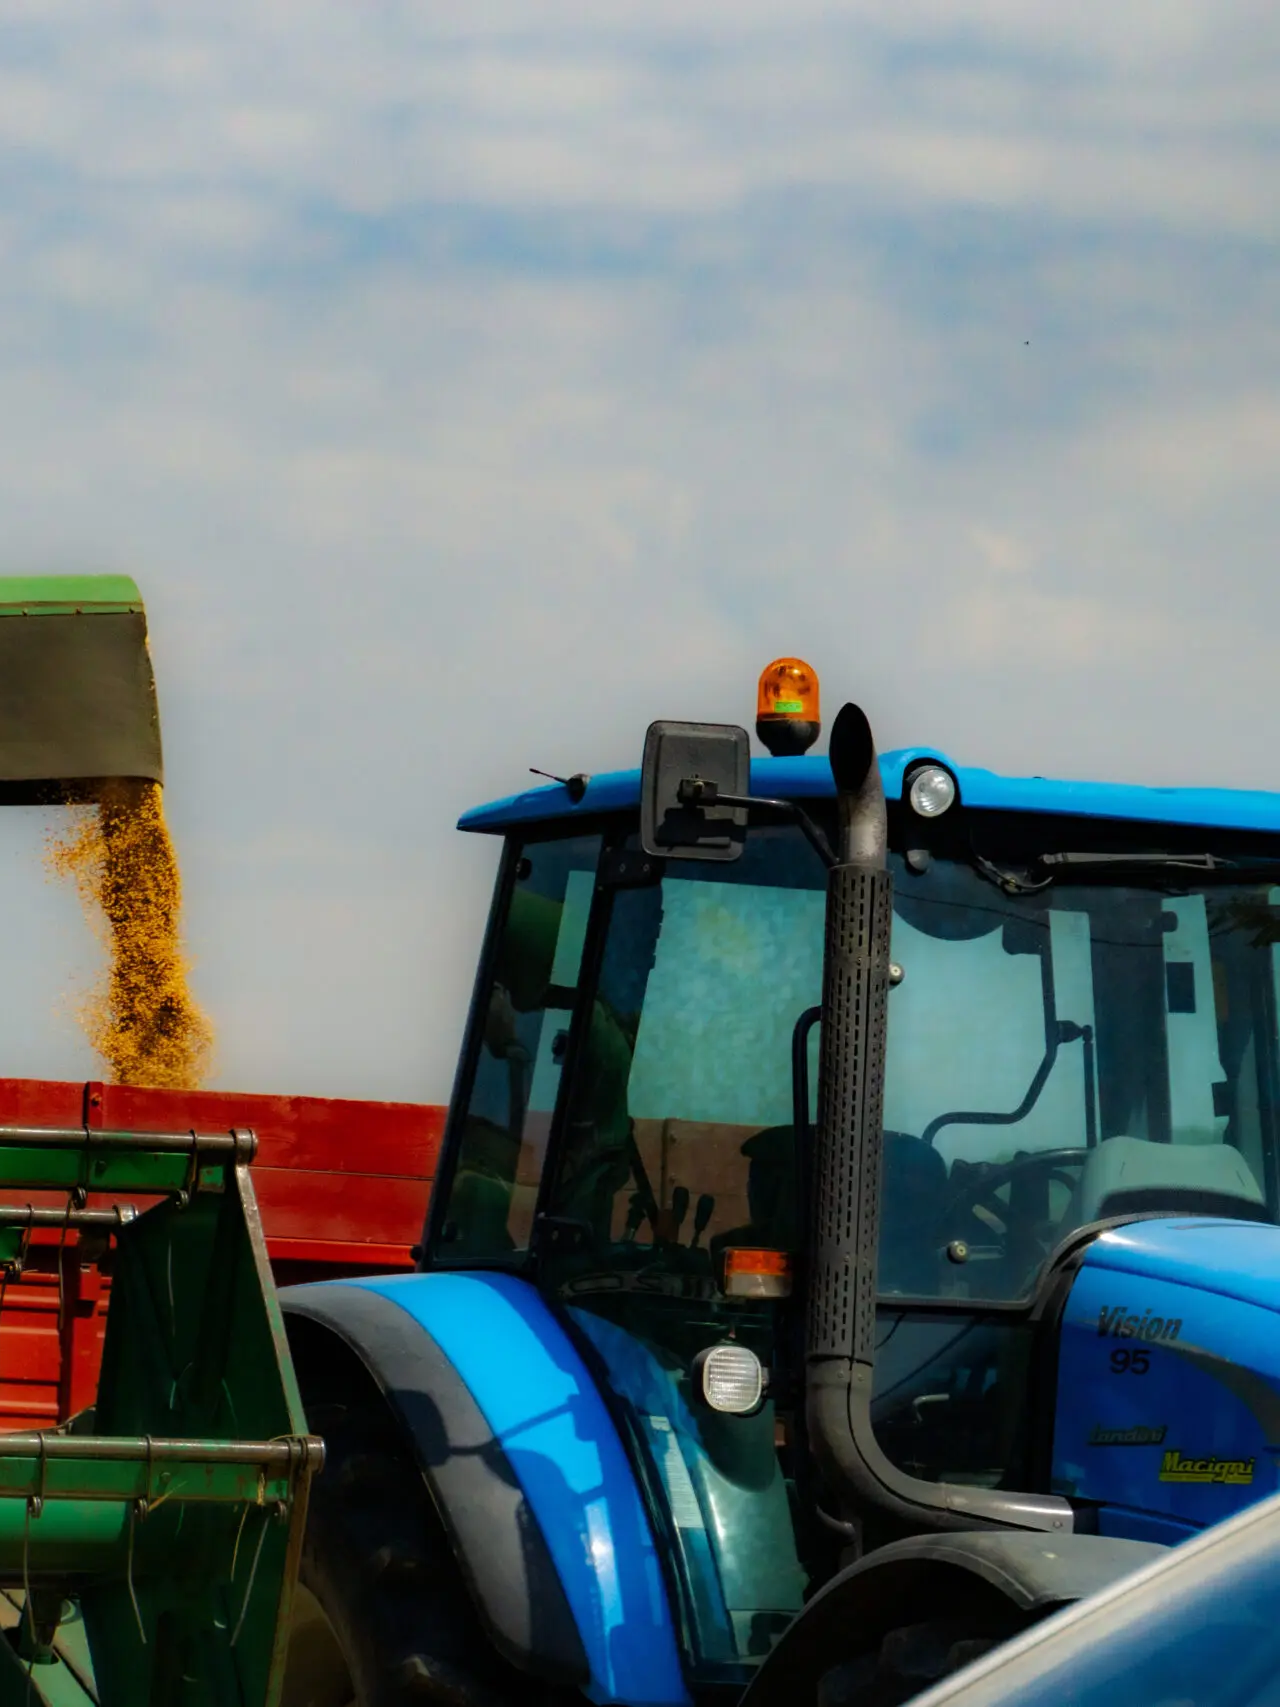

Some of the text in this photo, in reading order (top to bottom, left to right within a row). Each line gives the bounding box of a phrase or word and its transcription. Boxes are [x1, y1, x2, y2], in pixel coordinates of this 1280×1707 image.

[1097, 1305, 1183, 1340] Vision
[1109, 1348, 1151, 1375] 95
[1160, 1451, 1256, 1482] Macigni
